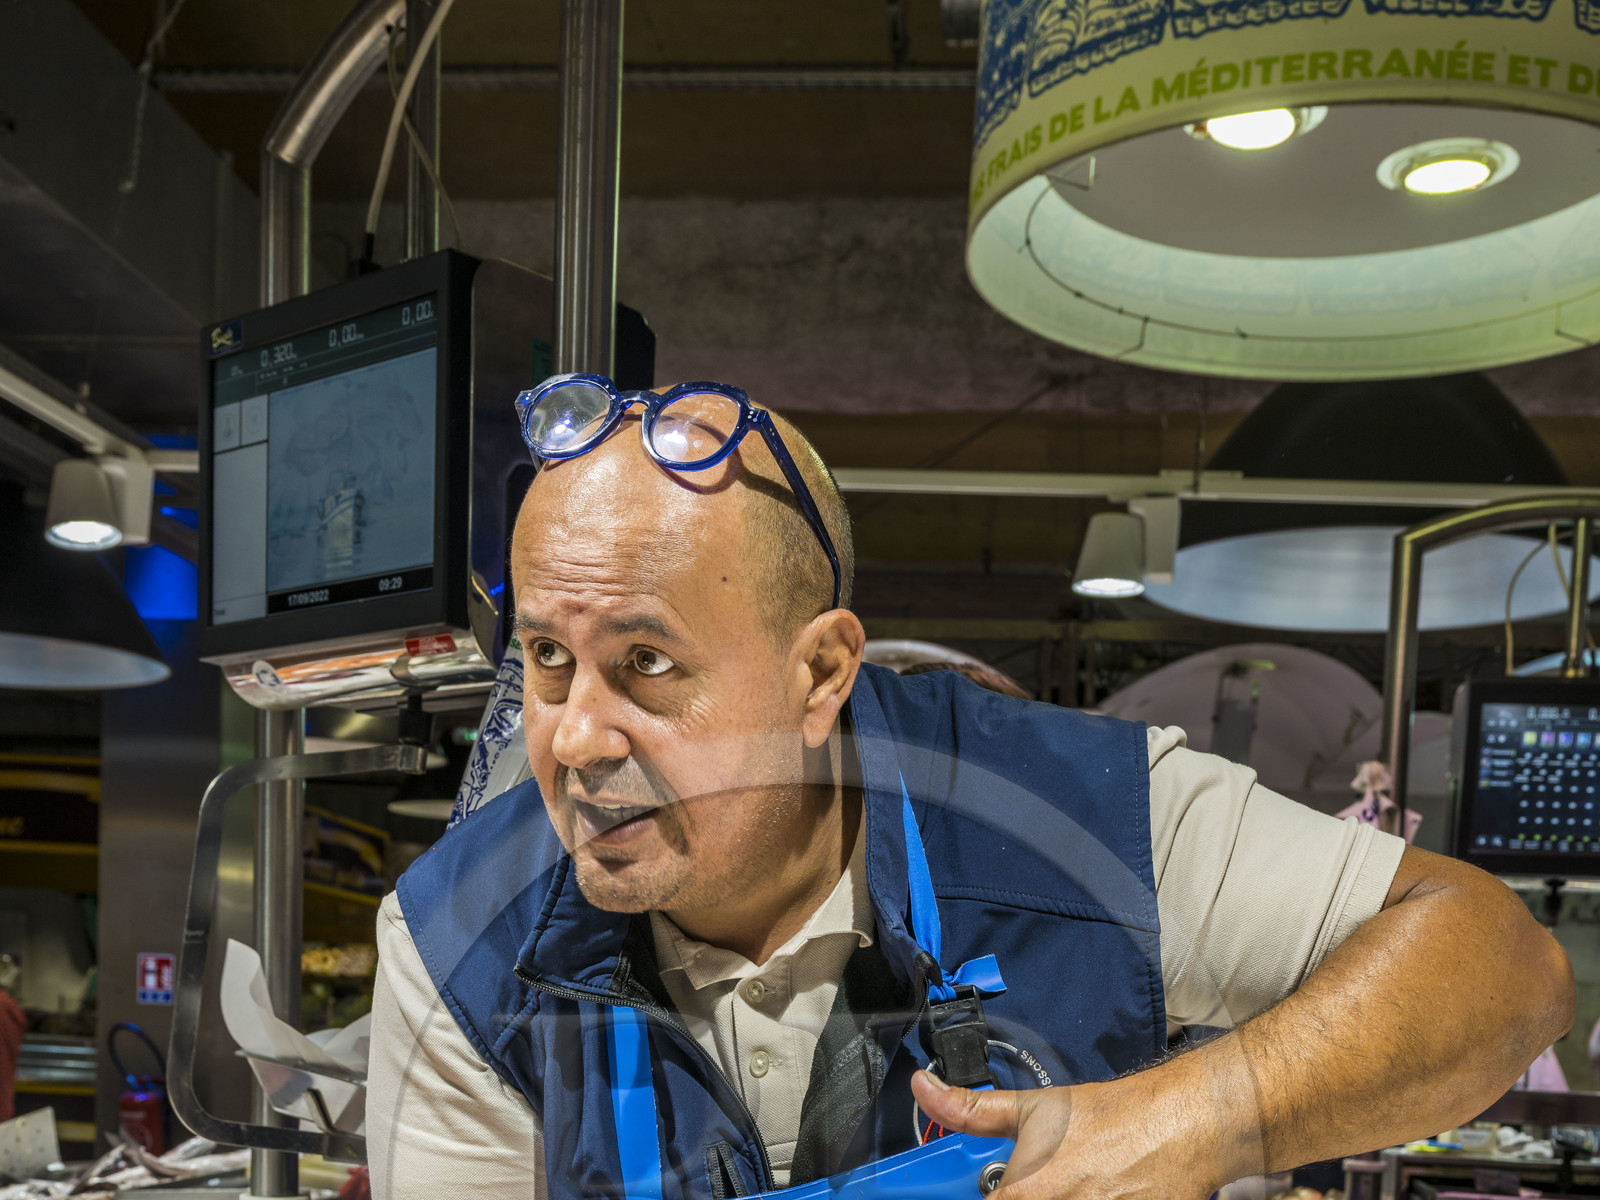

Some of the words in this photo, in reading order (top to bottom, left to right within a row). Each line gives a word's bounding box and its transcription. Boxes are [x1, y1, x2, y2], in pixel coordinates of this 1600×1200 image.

[988, 124, 1042, 186] FRAIS
[1049, 104, 1085, 142] DE
[1094, 85, 1141, 121] LA
[1153, 41, 1495, 107] MÉDITERRANÉE
[1508, 55, 1558, 88] ET
[1568, 63, 1600, 96] D
[288, 589, 329, 607] 17/09/2022
[379, 577, 402, 592] 09:29
